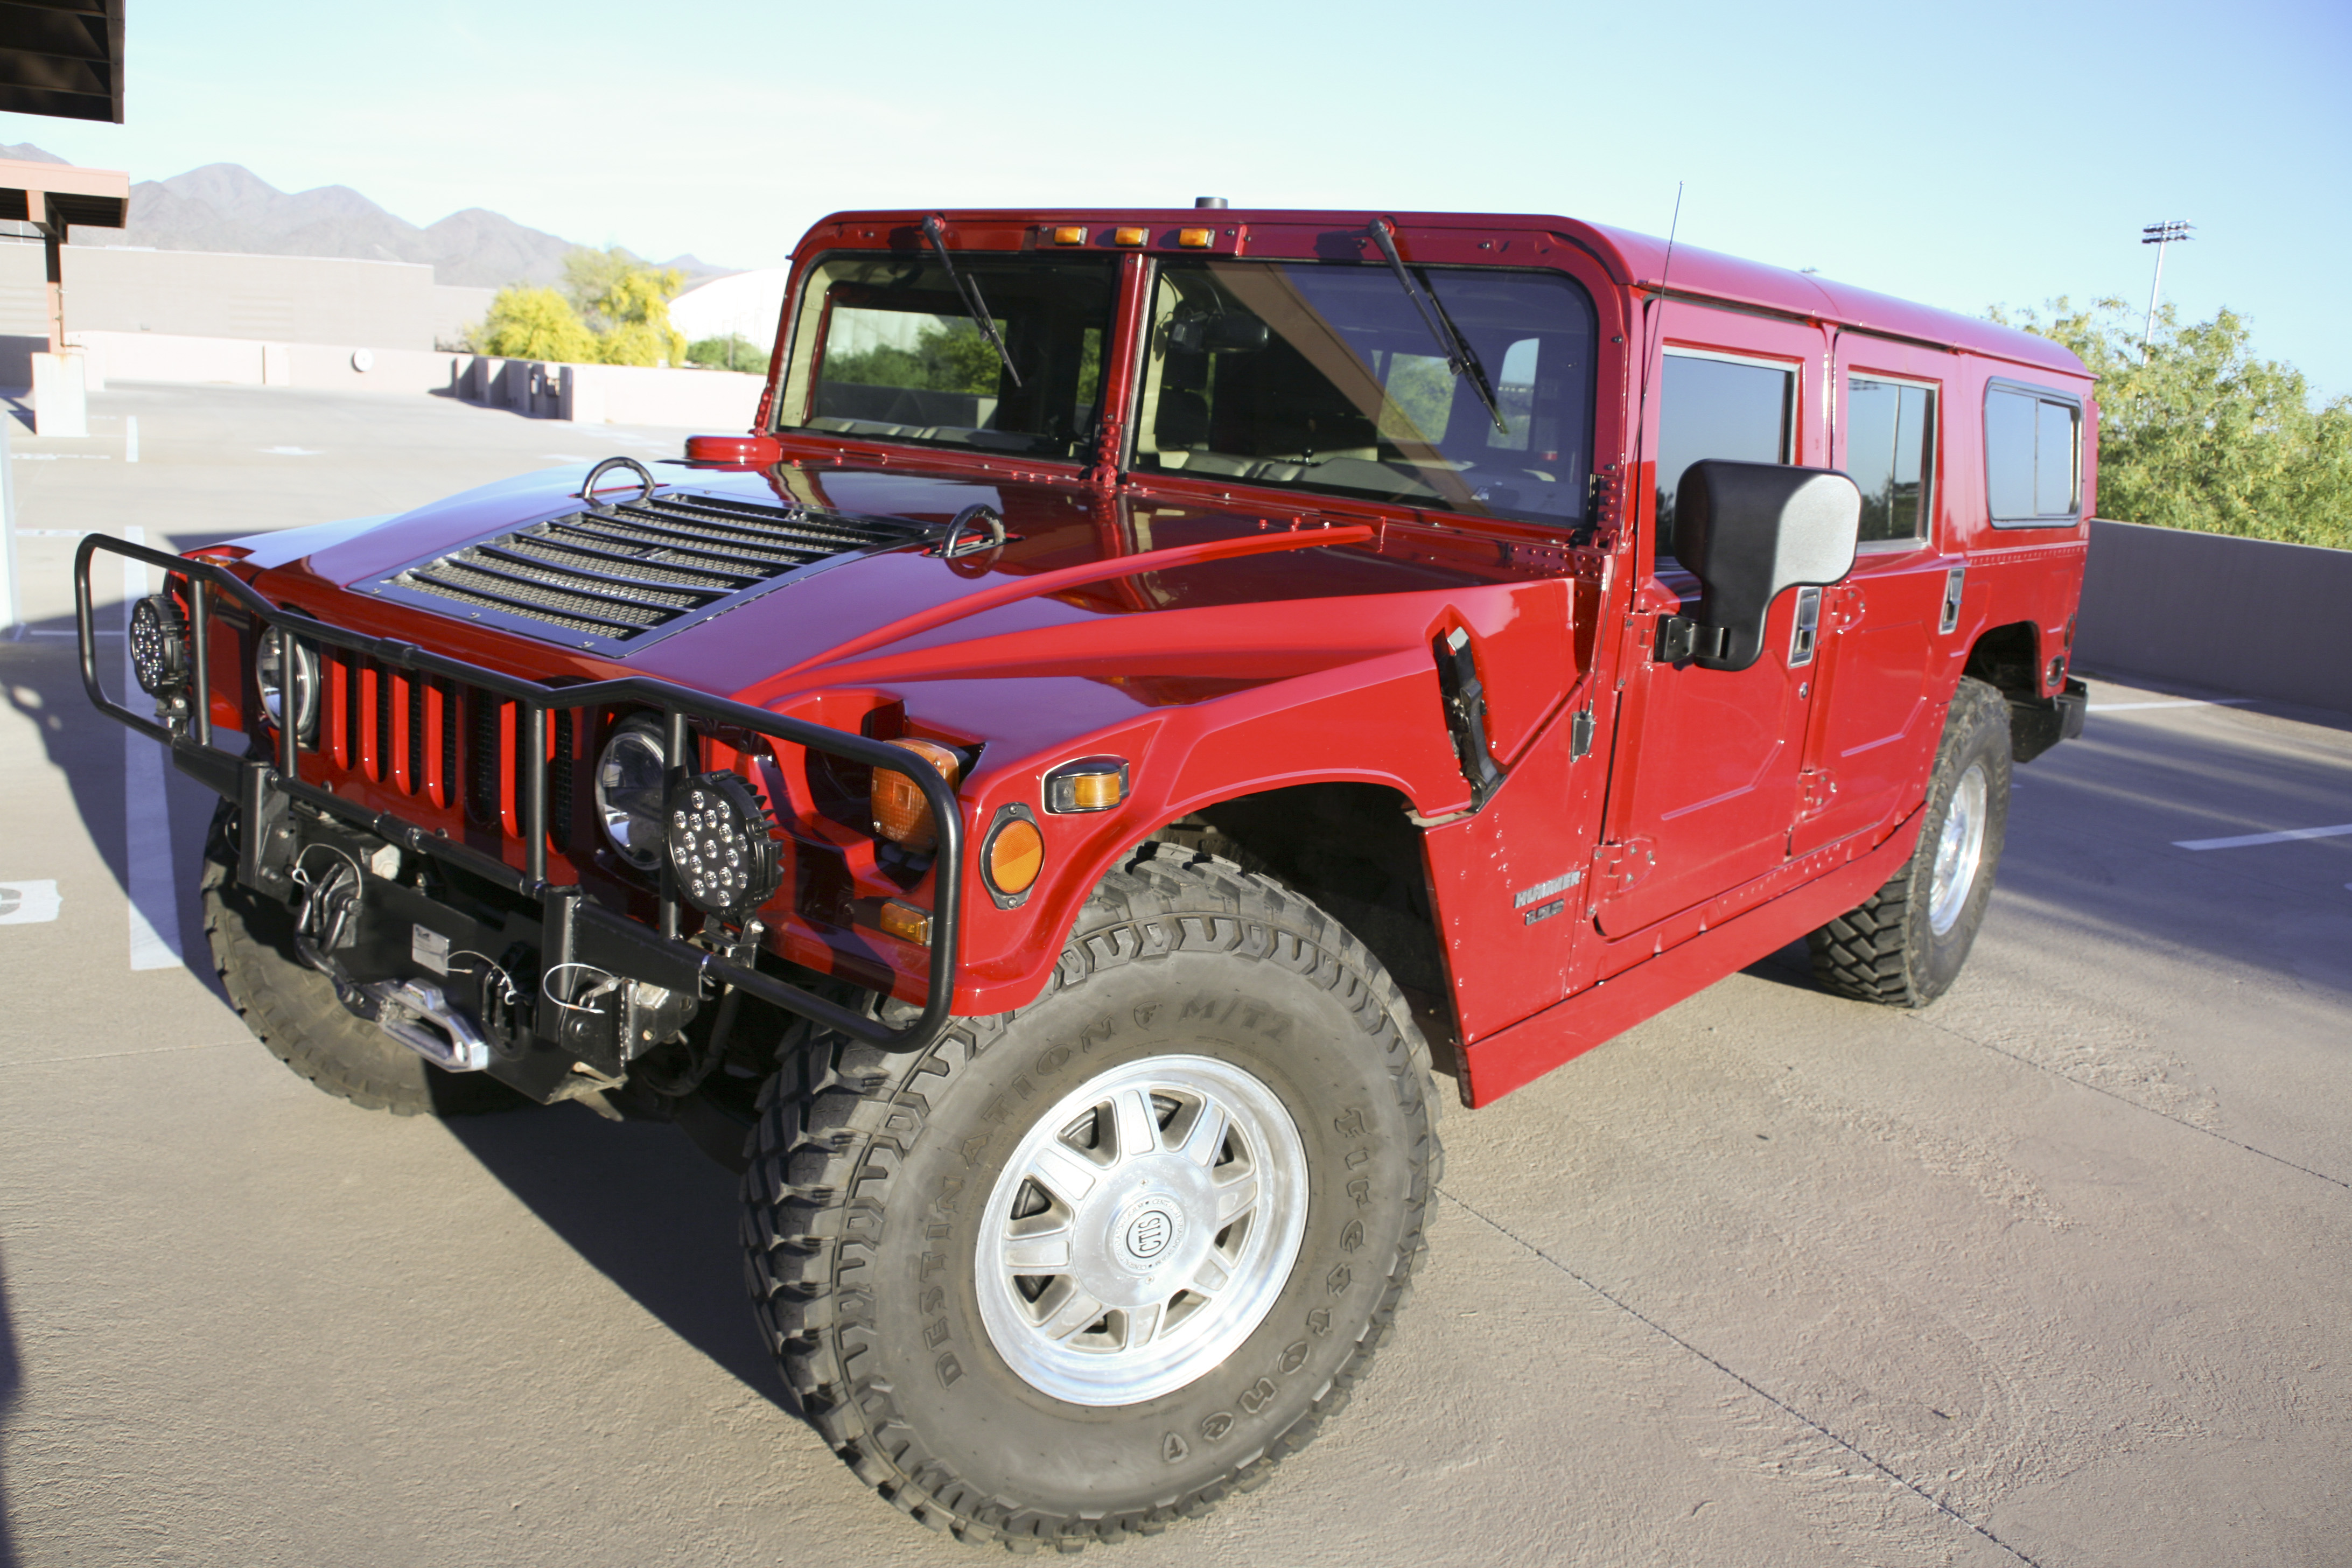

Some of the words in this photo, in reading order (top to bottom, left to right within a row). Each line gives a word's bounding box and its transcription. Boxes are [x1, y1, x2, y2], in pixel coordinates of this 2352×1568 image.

[1514, 870, 1581, 908] HUMMER
[920, 1014, 1116, 1390] DESTINATION
[1137, 1217, 1161, 1251] CTIS
[1201, 1108, 1375, 1442] Firestone
